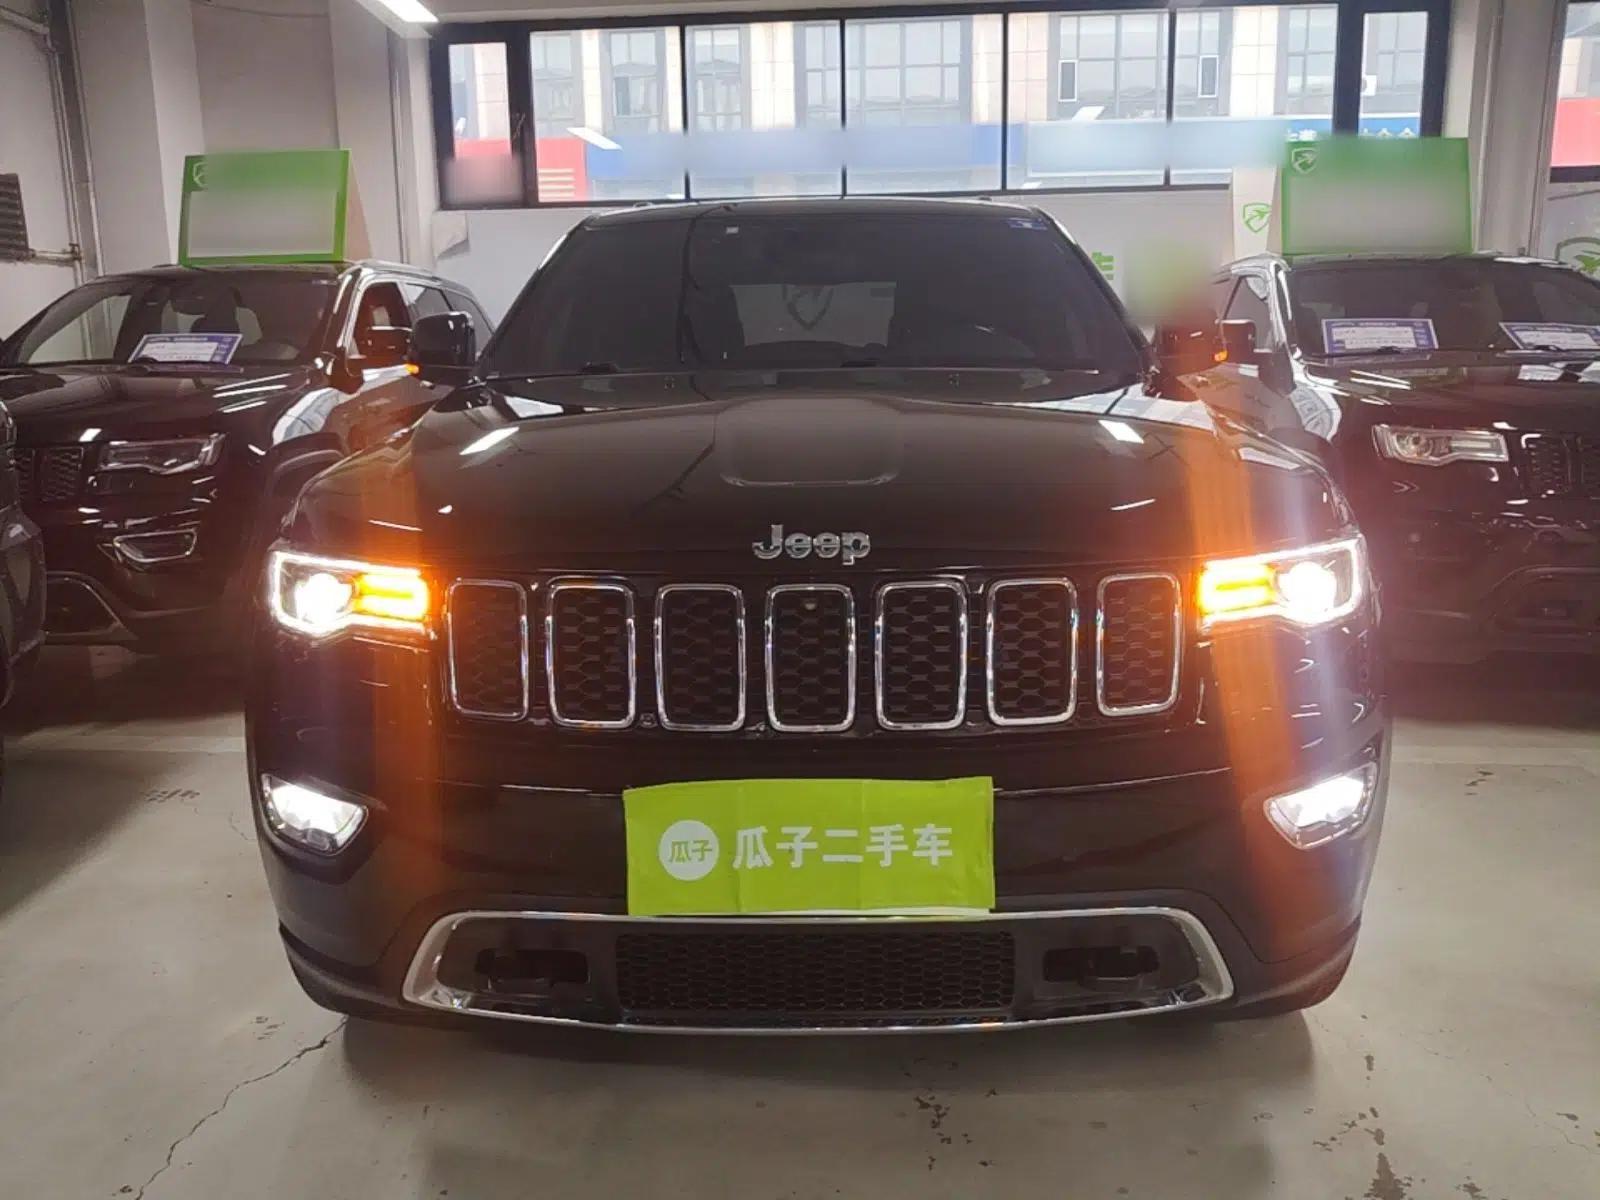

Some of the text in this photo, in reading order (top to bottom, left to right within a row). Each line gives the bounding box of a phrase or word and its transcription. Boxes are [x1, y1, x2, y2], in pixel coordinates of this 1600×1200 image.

[751, 524, 871, 565] Jeep
[669, 839, 713, 865] 瓜子
[732, 823, 954, 869] 瓜子二手车
